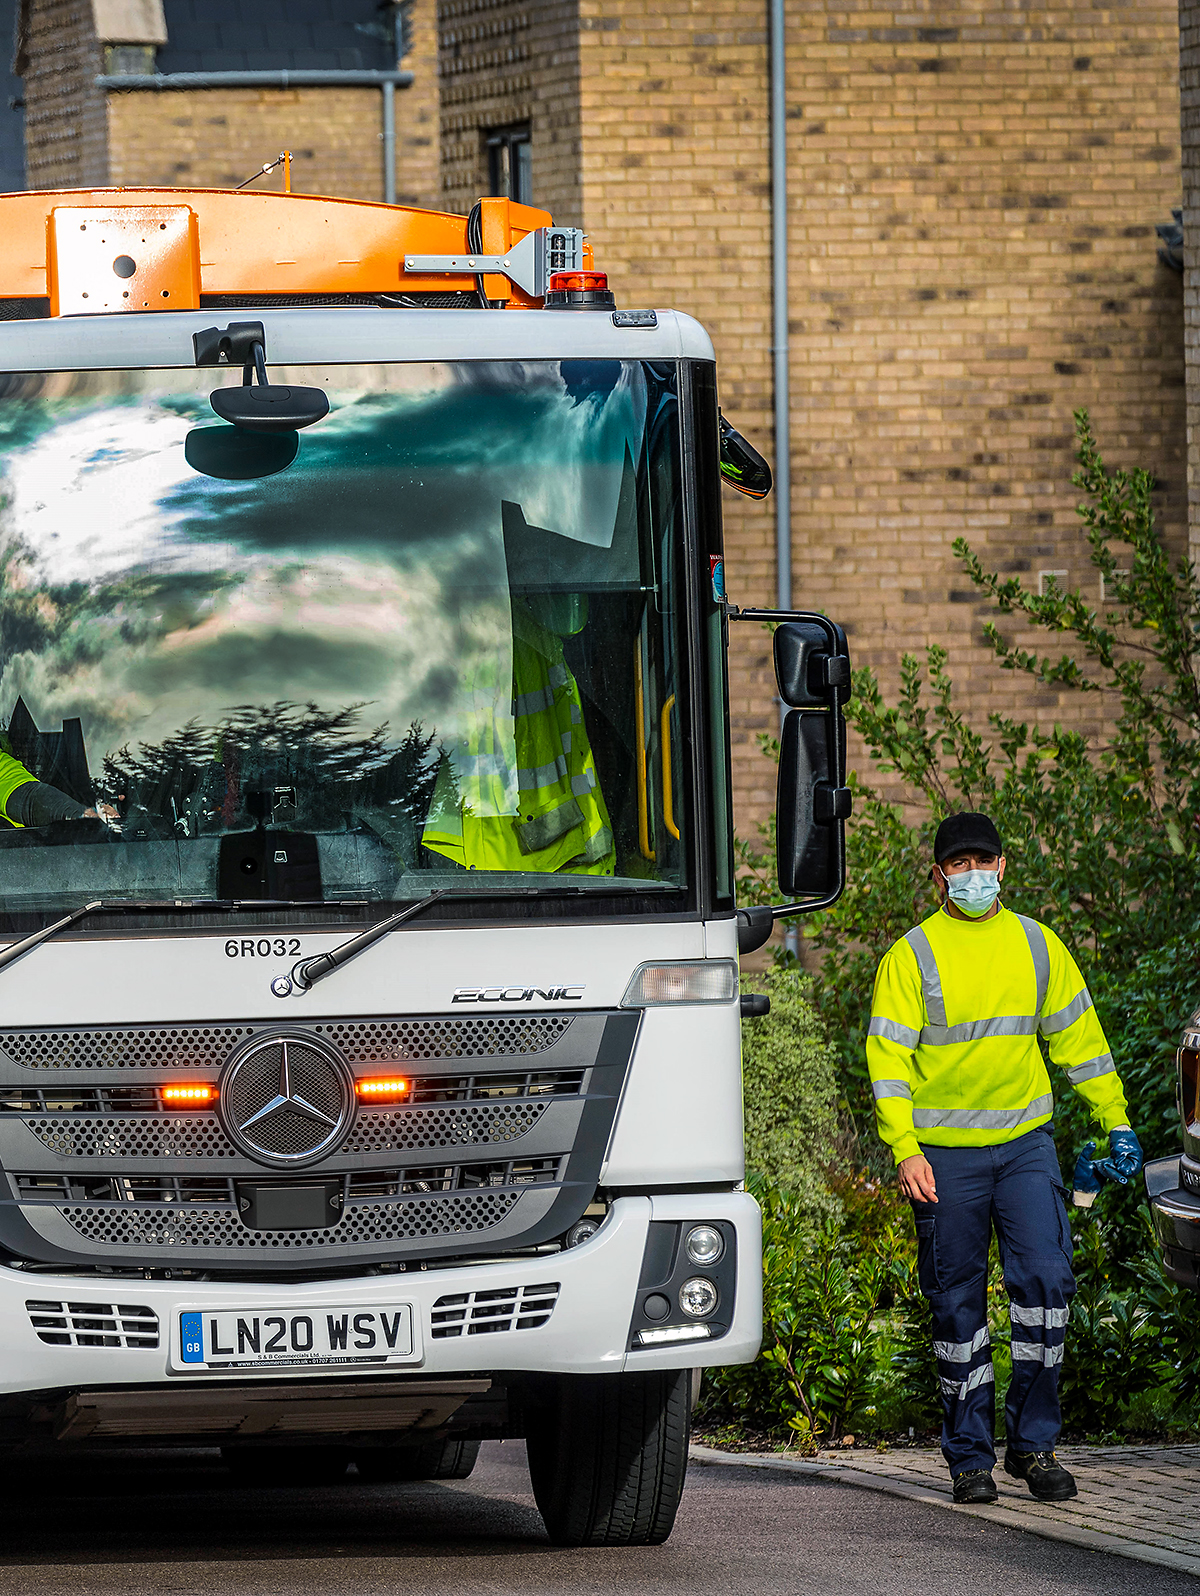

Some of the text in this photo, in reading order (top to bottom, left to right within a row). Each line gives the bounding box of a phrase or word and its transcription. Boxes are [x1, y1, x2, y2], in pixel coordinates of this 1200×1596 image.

[224, 937, 302, 959] 6R032
[451, 983, 587, 1004] ECONIC
[210, 1311, 403, 1356] LN20 WSV
[186, 1342, 201, 1353] GB
